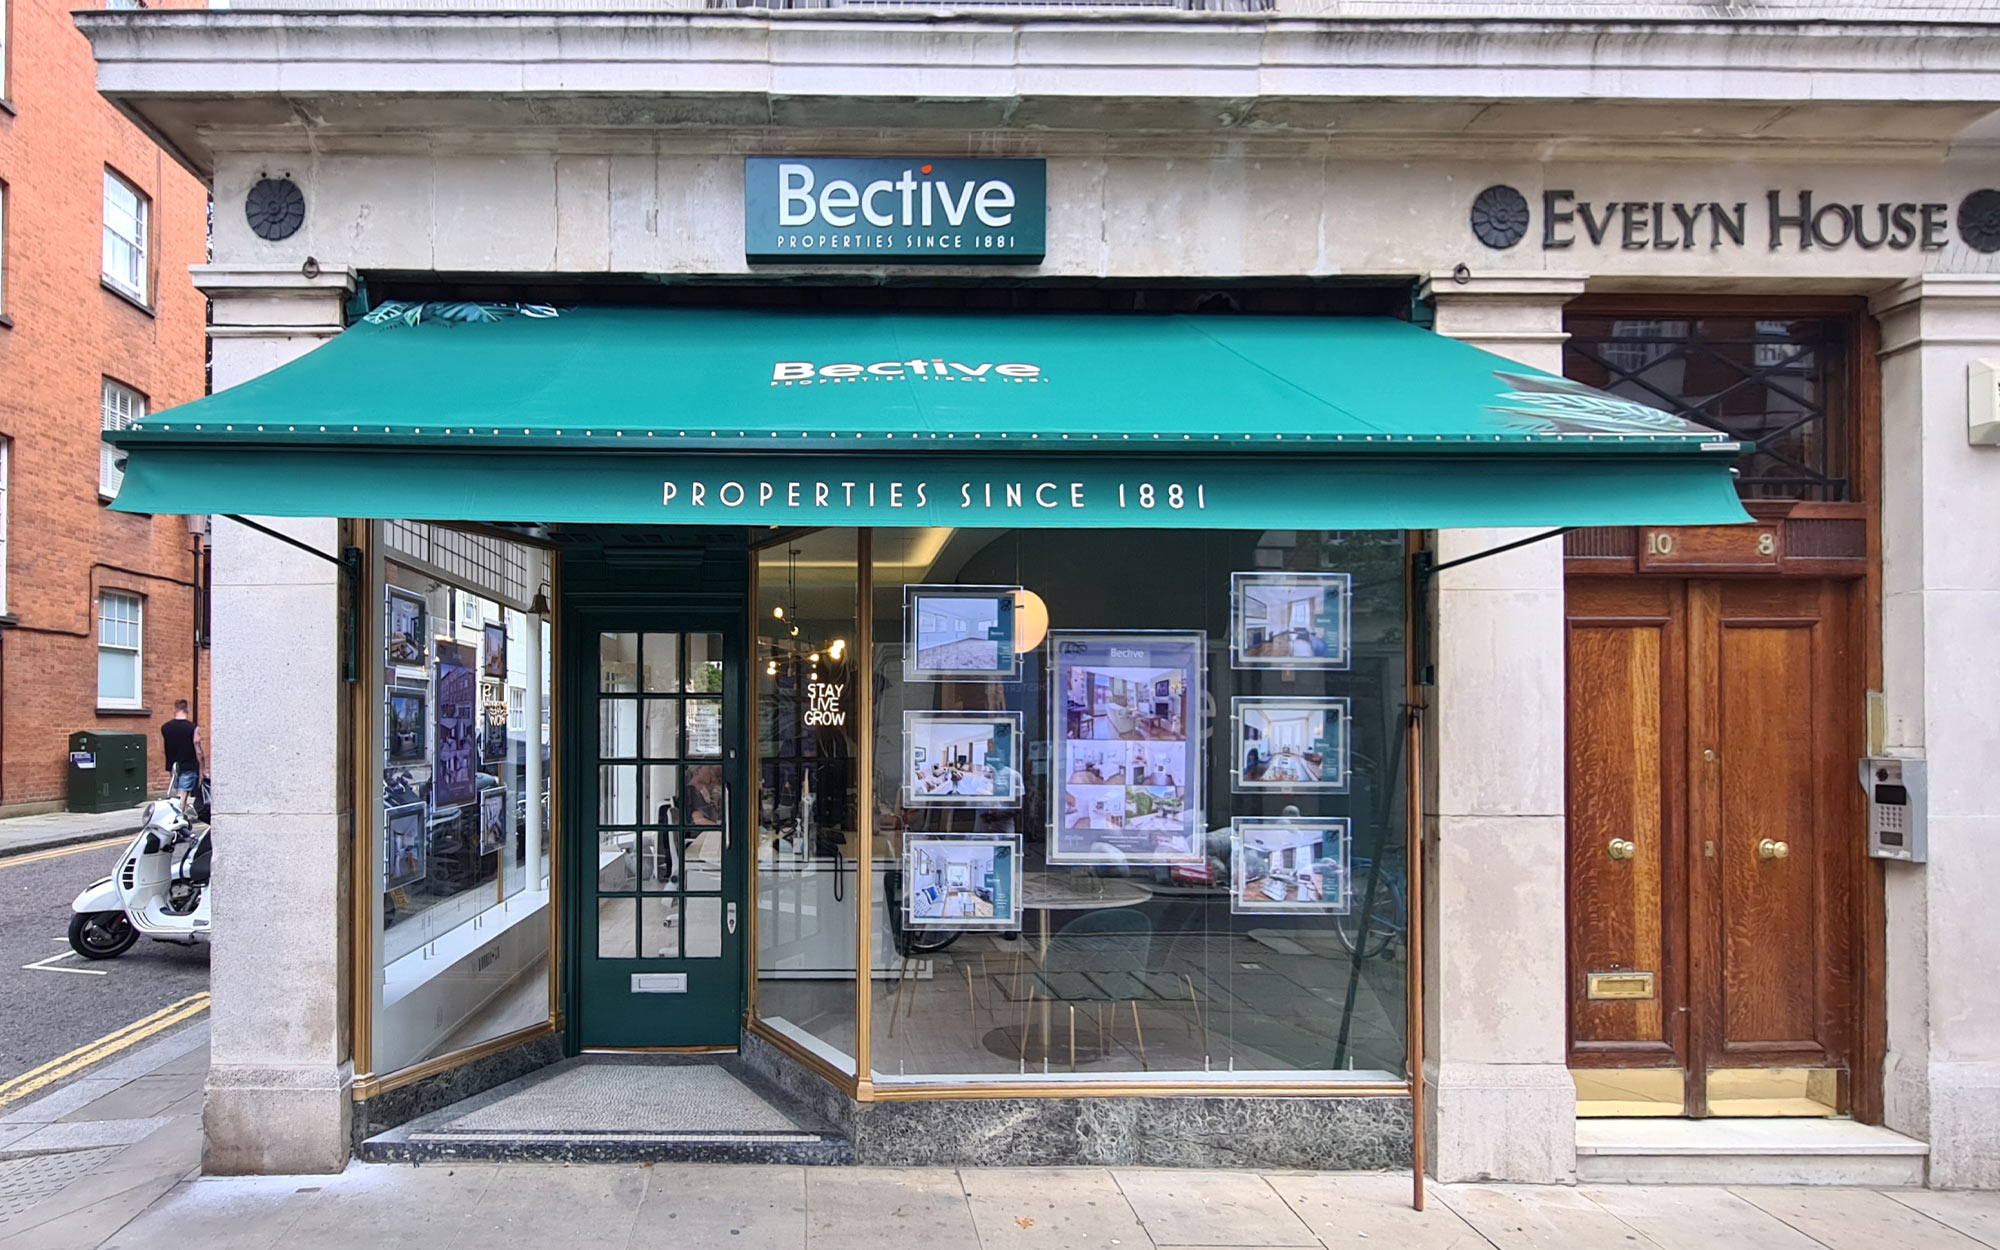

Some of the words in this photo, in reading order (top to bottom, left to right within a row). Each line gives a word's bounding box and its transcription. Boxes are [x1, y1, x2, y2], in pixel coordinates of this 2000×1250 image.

[778, 163, 1016, 227] Bective
[1542, 189, 1748, 250] EVELYN
[1767, 190, 1950, 250] HOUSE
[777, 235, 894, 248] PROPERTIES
[906, 235, 962, 248] SINCE
[975, 235, 1015, 248] 1881
[772, 358, 1041, 381] Bective
[662, 481, 927, 508] PROPERTIES
[961, 482, 1085, 508] SINCE
[1118, 483, 1206, 509] 1881
[1647, 533, 1672, 555] 10
[1758, 533, 1774, 555] 8
[1110, 647, 1145, 659] Bective
[807, 683, 844, 699] STAY
[810, 697, 839, 712] LIVE
[804, 710, 846, 726] GROW
